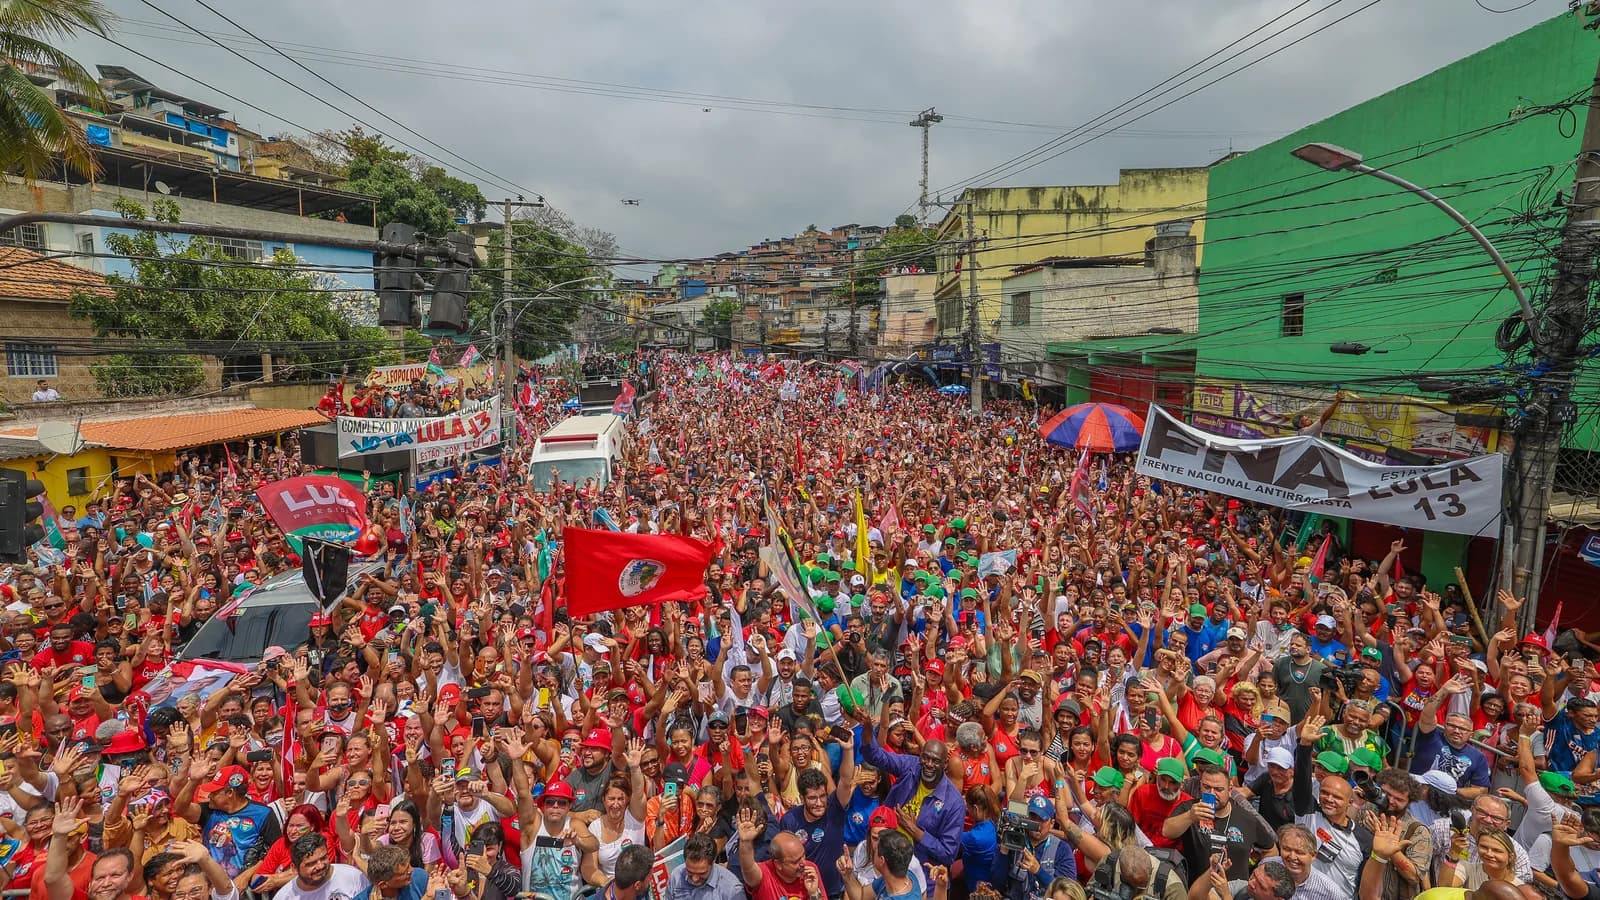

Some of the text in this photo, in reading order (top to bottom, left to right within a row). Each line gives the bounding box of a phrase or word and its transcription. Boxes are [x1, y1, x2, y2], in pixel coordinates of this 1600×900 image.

[341, 419, 391, 434] COMPLEXO
[351, 410, 492, 453] VOTA LULA 13
[464, 432, 498, 451] LULA
[1142, 458, 1353, 510] FRENTE NACIONAL ANTIRRACISTA
[1368, 464, 1482, 500] LULA
[280, 484, 356, 512] LUL
[1413, 493, 1467, 521] 13
